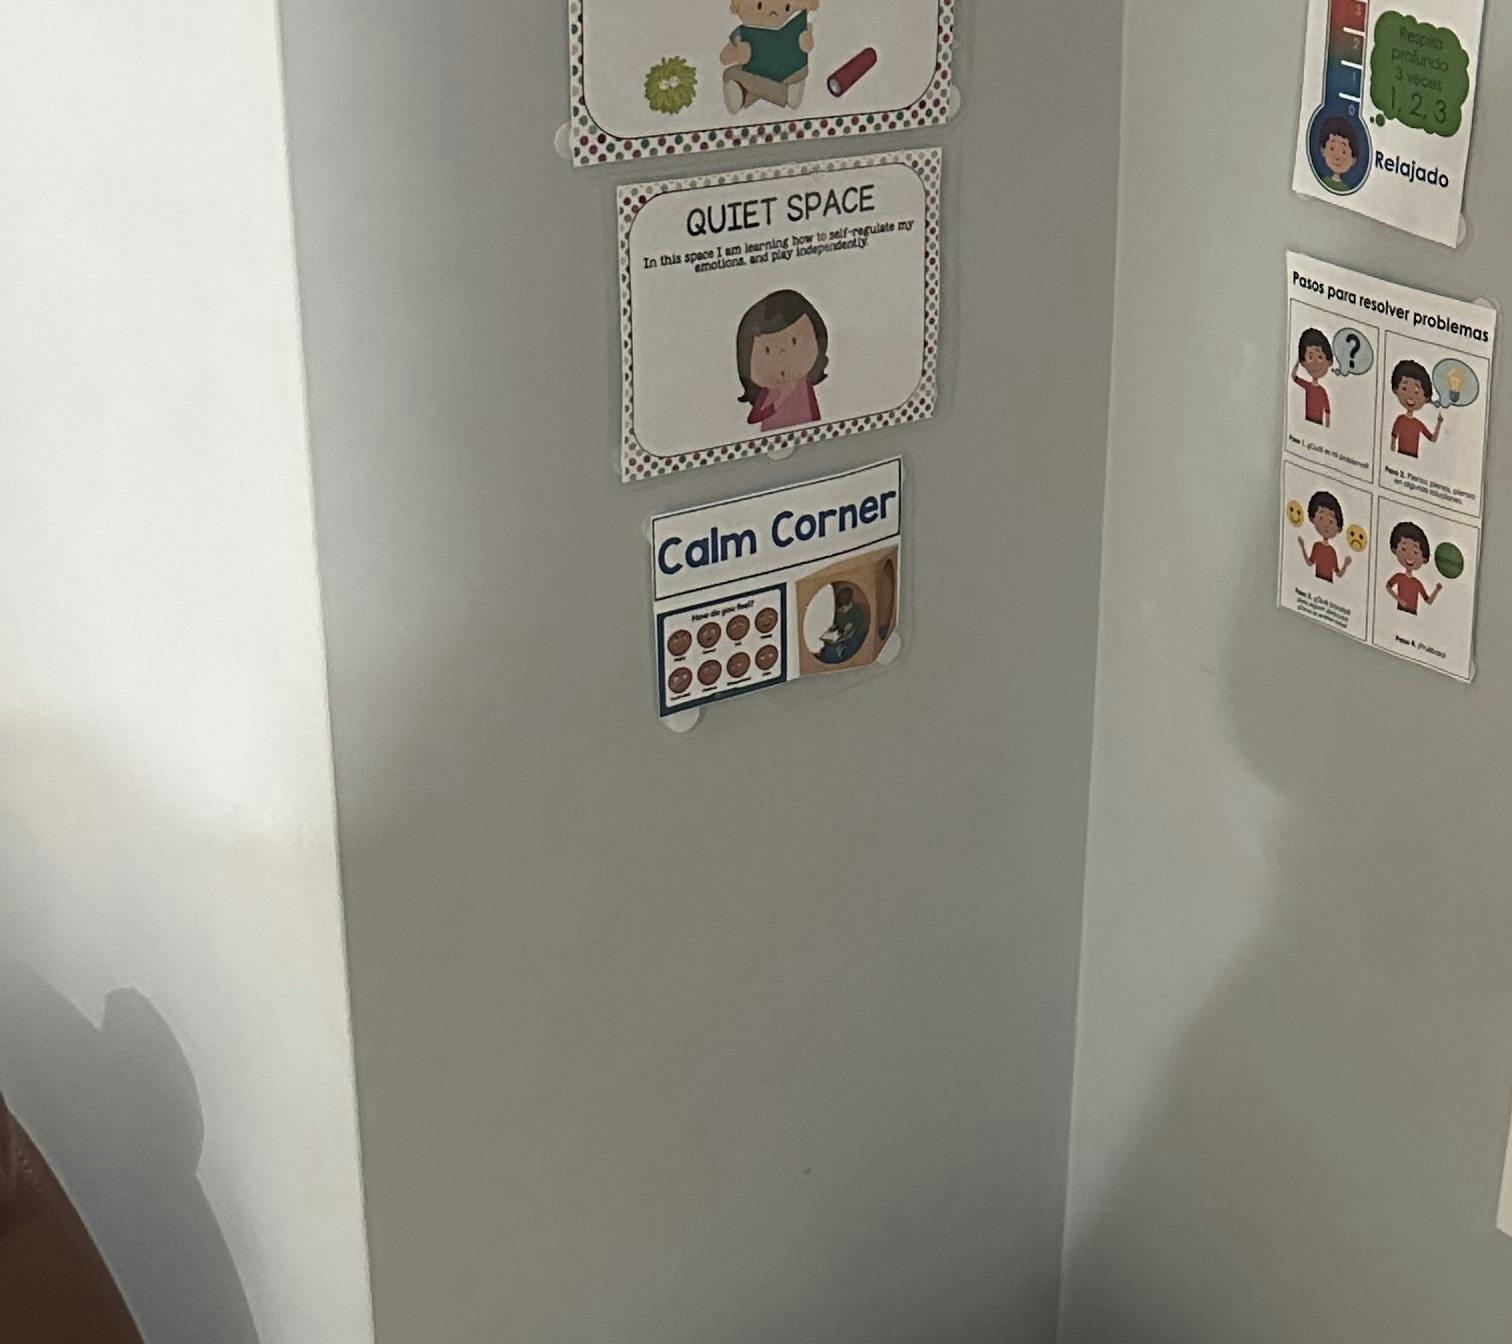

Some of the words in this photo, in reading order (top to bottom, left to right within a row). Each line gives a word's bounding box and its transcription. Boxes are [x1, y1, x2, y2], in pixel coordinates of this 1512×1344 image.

[1436, 99, 1447, 124] 3
[1375, 151, 1449, 188] Relajado
[687, 197, 778, 236] QUIET
[787, 184, 874, 222] SPACE
[644, 257, 656, 269] In
[661, 253, 681, 266] this
[685, 249, 714, 266] space
[717, 246, 722, 258] I
[725, 246, 741, 257] am
[745, 239, 789, 254] learning
[792, 233, 813, 246] how
[817, 232, 826, 242] to
[829, 222, 895, 240] self-regulate
[898, 220, 914, 232] my
[750, 251, 768, 264] and
[771, 248, 793, 264] play
[1293, 271, 1324, 294] Pasos
[1328, 285, 1356, 304] para
[1359, 296, 1410, 321] resolver
[1414, 312, 1489, 343] problemas
[657, 526, 756, 575] Calm
[771, 488, 897, 549] Corner
